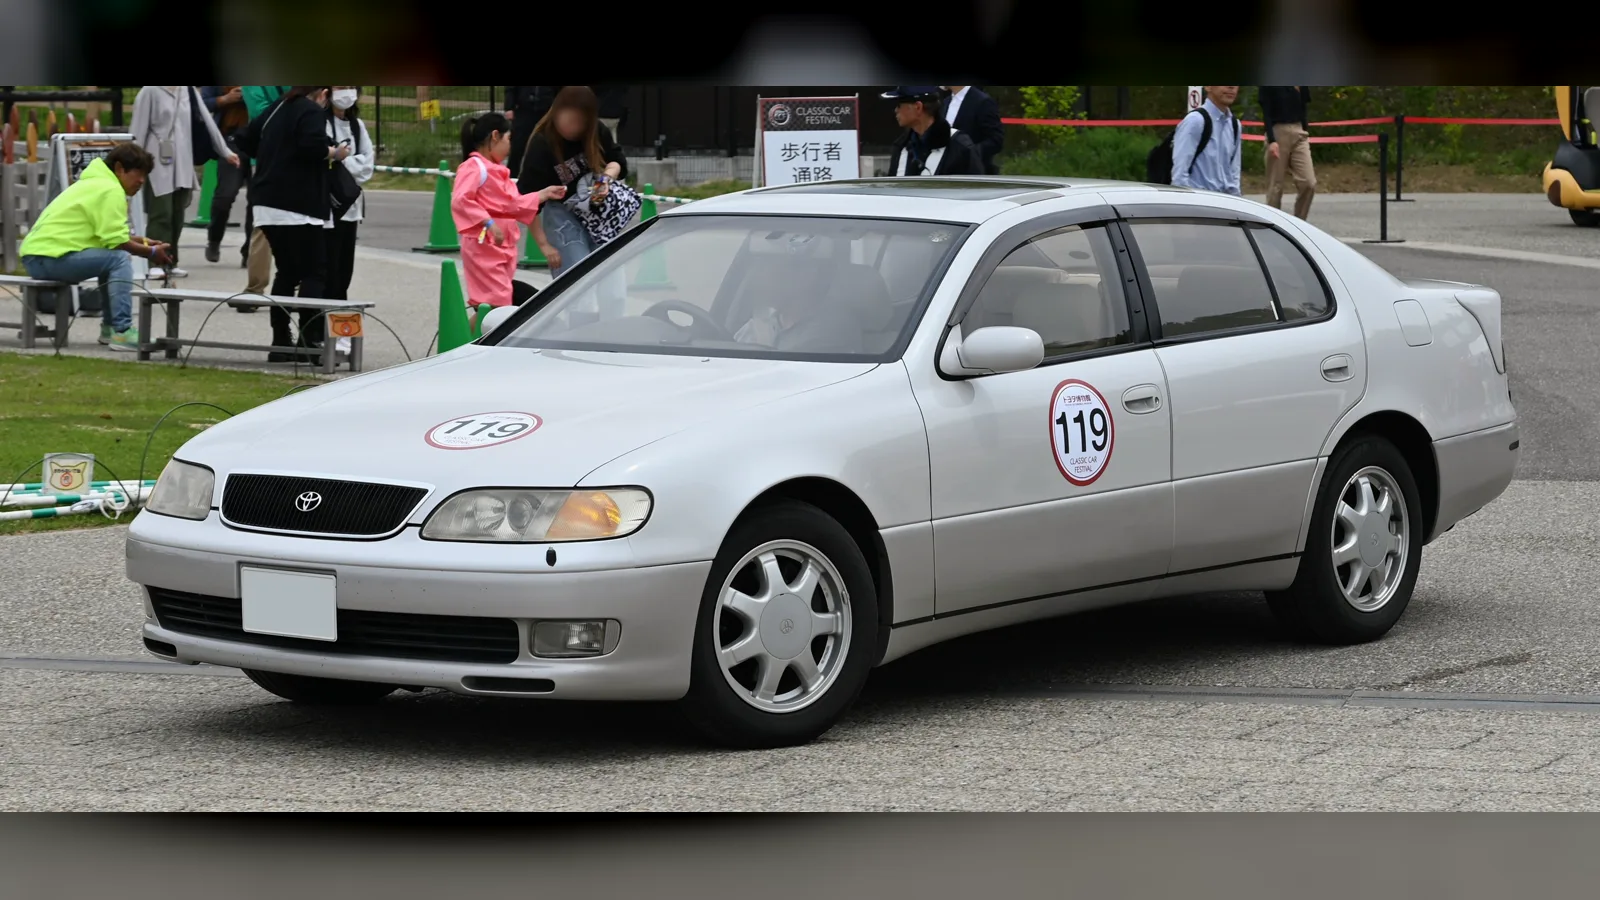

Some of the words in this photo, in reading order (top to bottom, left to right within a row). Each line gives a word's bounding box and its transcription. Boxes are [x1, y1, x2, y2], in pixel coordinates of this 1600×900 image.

[796, 107, 831, 116] CLASSIC
[833, 107, 851, 115] CAR
[806, 116, 842, 125] FESTIVAL
[781, 142, 842, 162] 歩行者
[793, 166, 833, 183] 通路
[444, 419, 529, 438] 119
[1056, 408, 1108, 454] 119
[1070, 456, 1088, 465] CLASSIC
[1088, 456, 1097, 464] CAR
[1074, 464, 1093, 473] FESTIVAL
